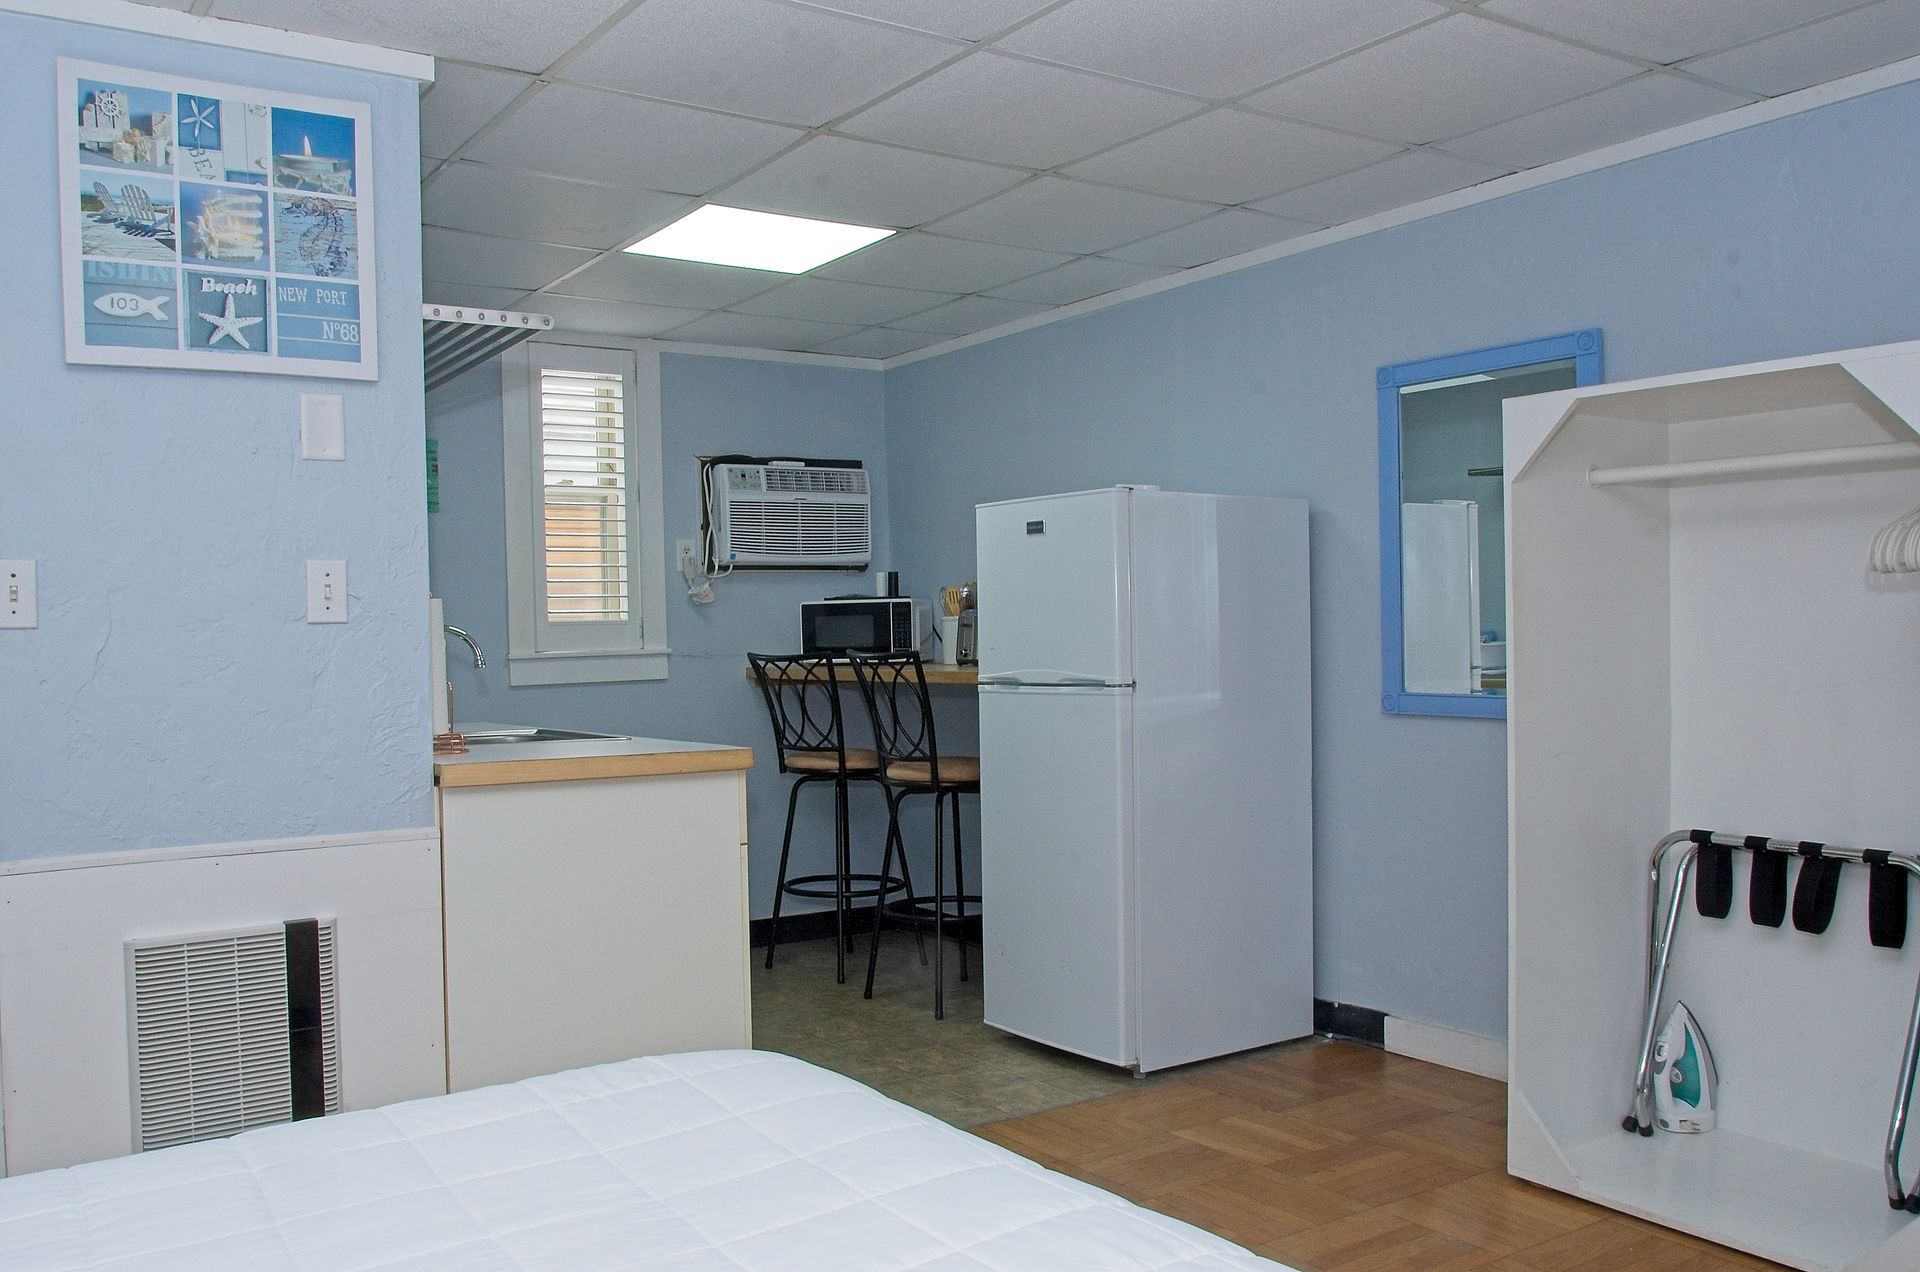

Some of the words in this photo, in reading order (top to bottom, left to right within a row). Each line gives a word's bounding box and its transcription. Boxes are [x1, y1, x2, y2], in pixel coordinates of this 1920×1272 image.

[200, 277, 258, 295] Beach
[110, 297, 140, 311] 103
[278, 286, 308, 303] NEW
[316, 288, 348, 306] PORT
